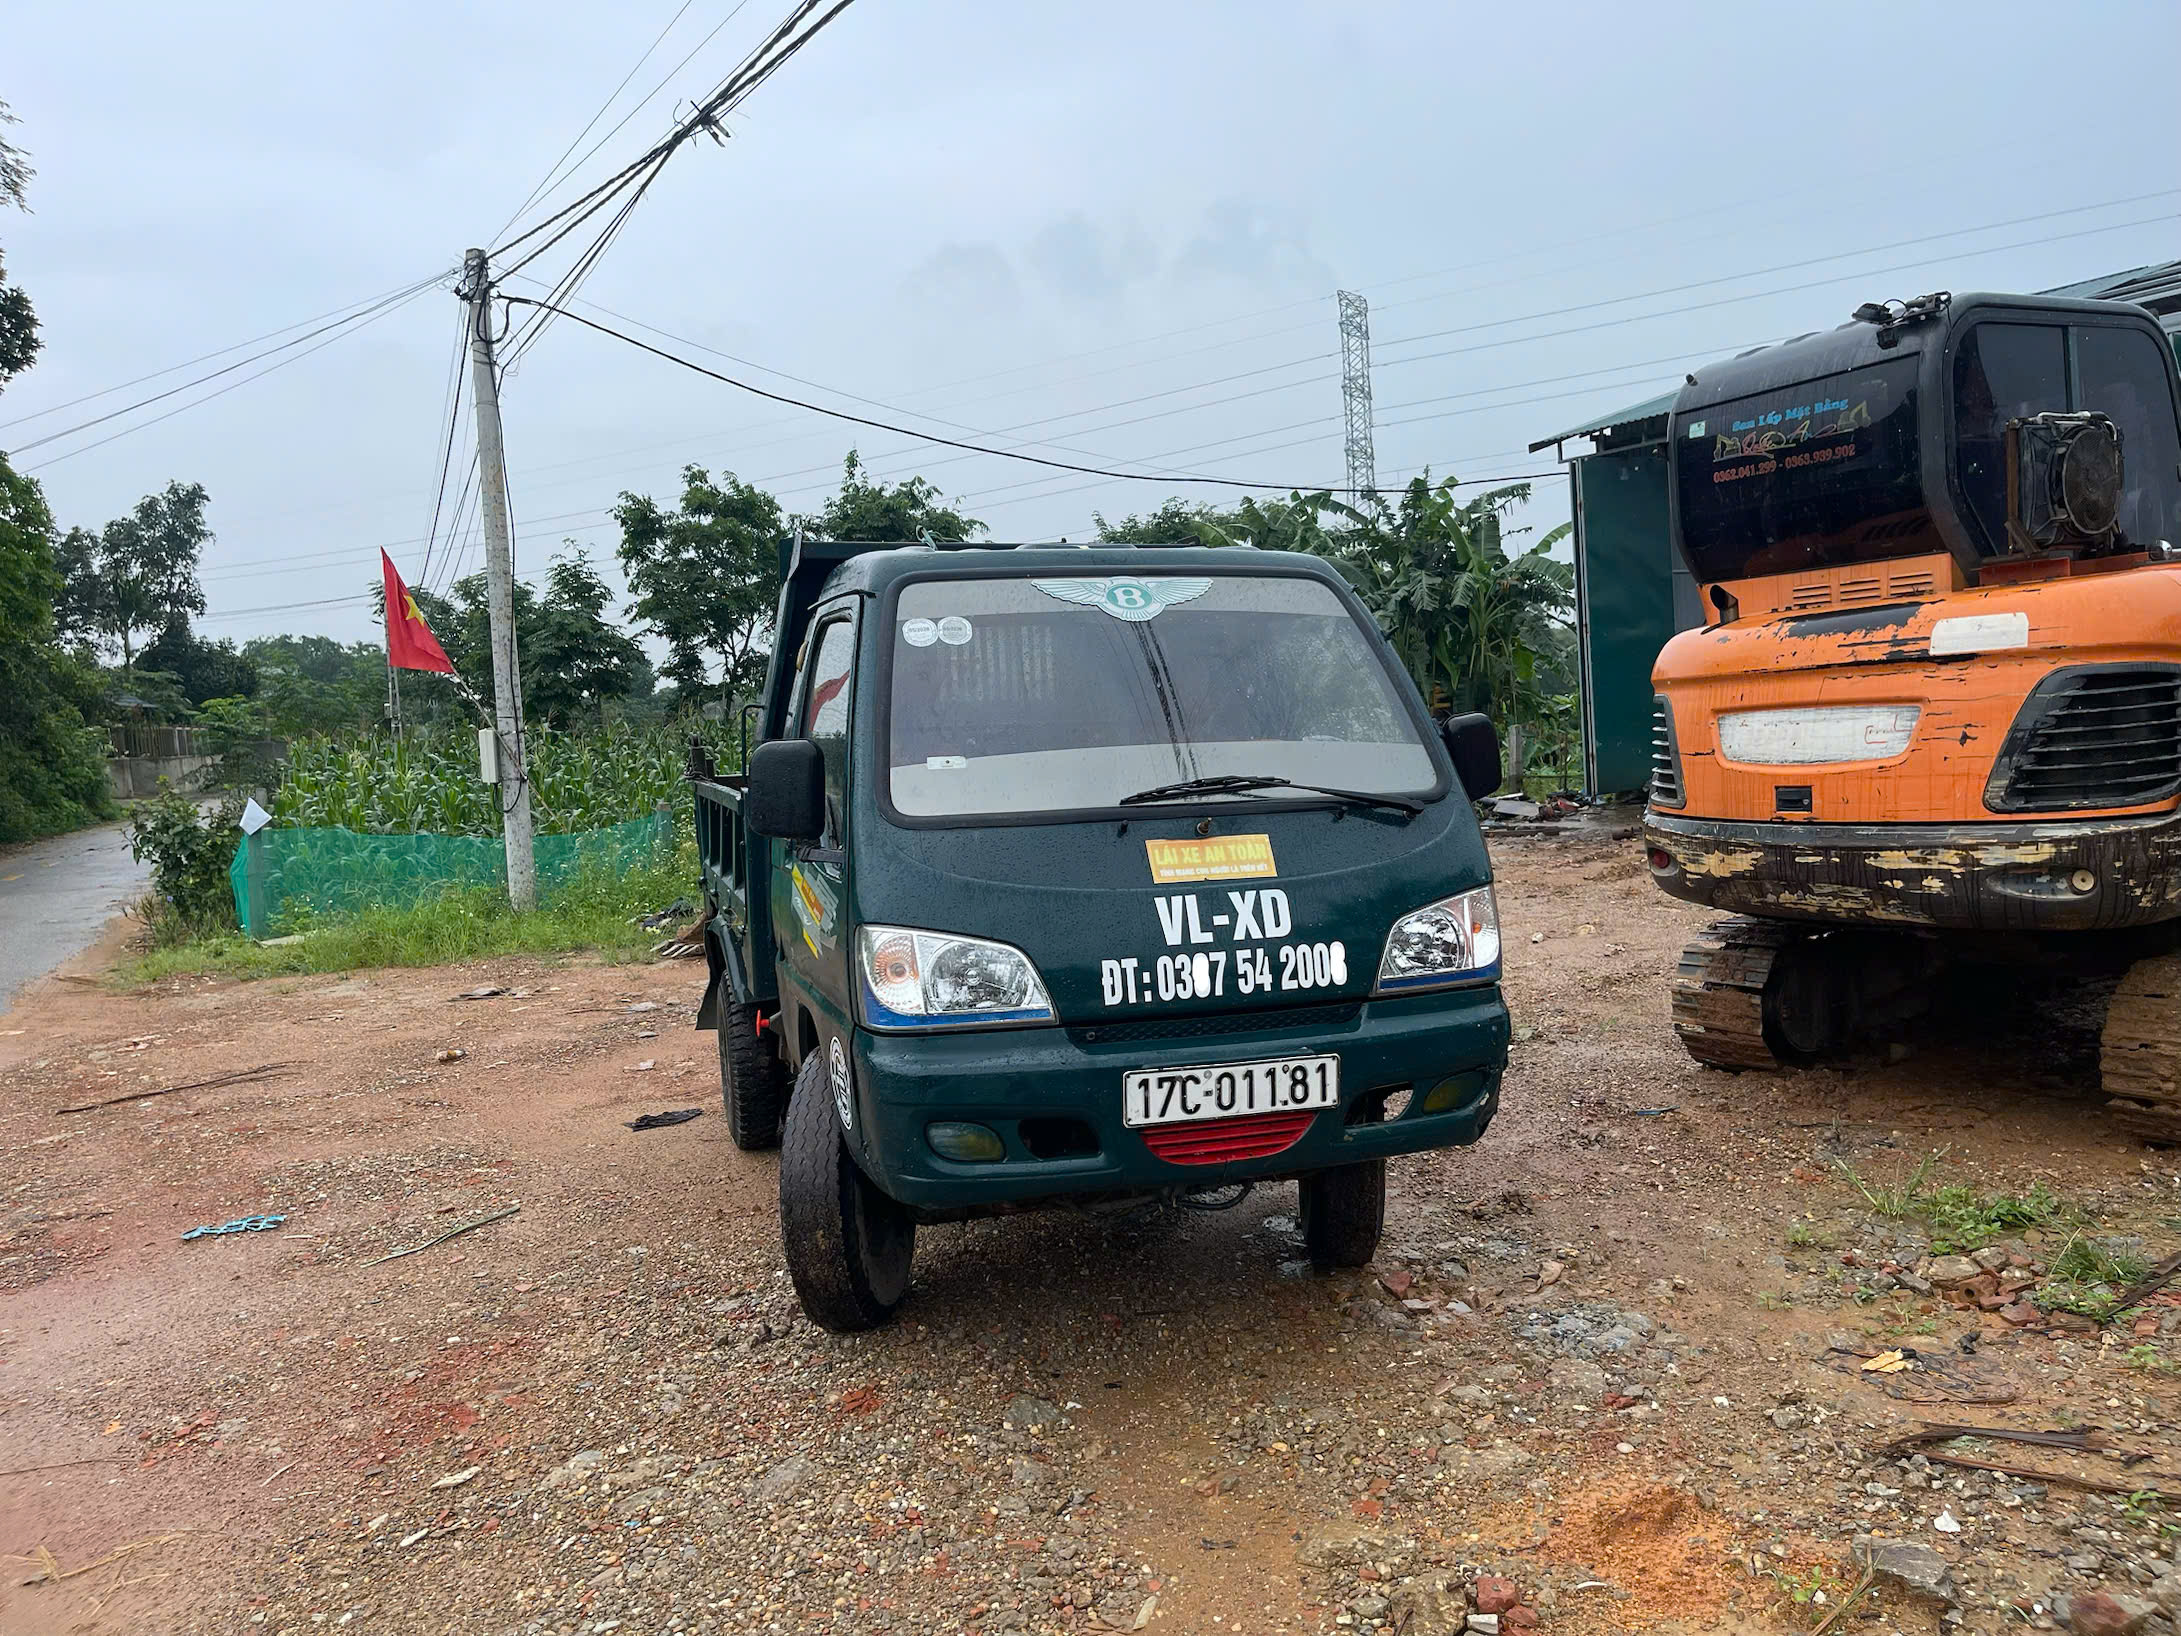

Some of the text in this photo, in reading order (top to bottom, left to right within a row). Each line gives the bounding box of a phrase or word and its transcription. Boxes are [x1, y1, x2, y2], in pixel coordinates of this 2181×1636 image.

[1181, 846, 1199, 864] XE
[1205, 845, 1225, 863] AN
[1154, 888, 1292, 946] VL-XD
[1101, 951, 1227, 1006] ĐT:037
[1236, 947, 1273, 995] 54
